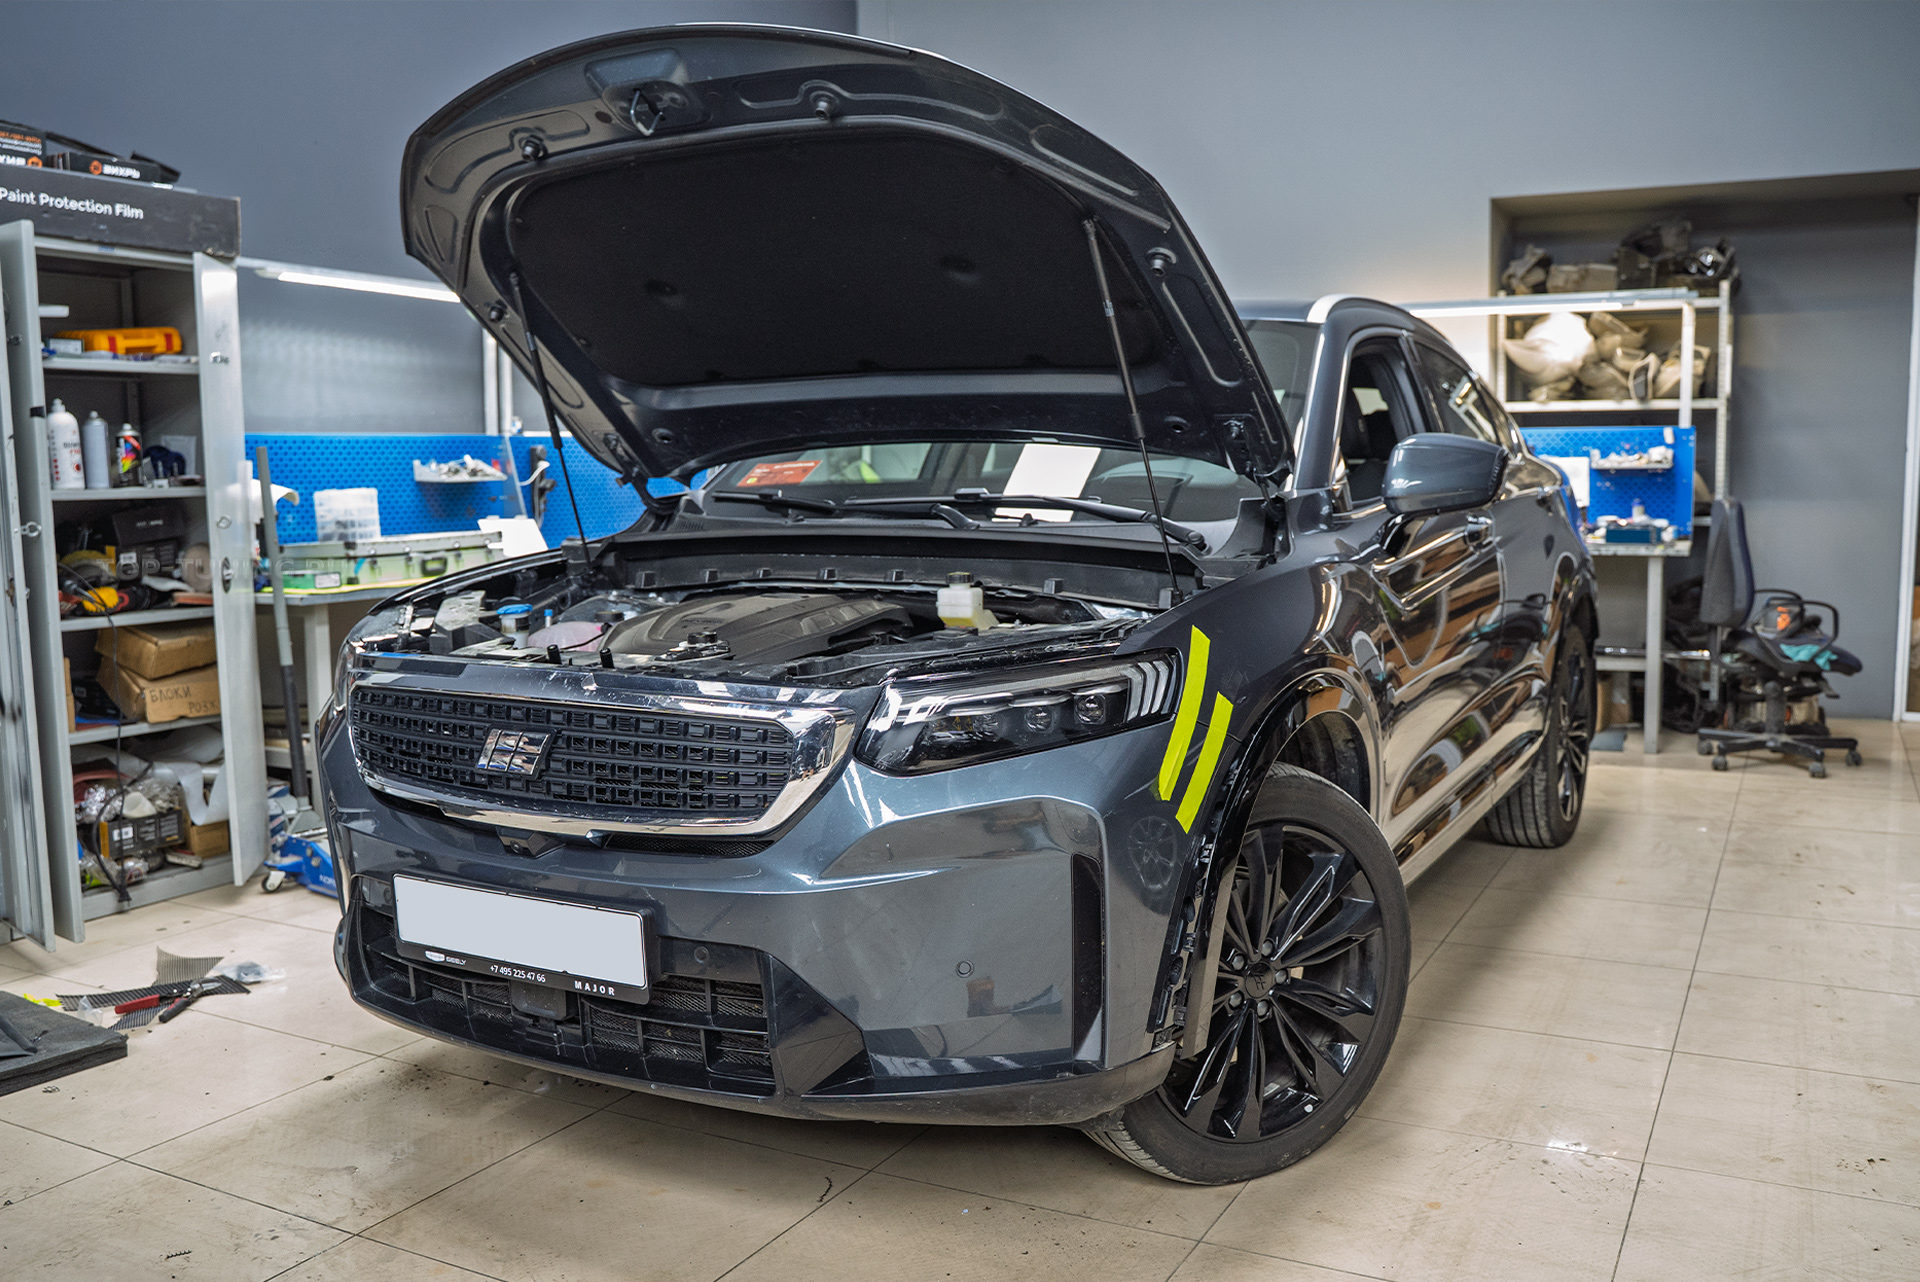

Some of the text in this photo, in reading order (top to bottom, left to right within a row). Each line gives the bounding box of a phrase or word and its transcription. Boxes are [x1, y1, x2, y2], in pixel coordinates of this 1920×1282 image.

[0, 187, 144, 220] Paint Protection Film
[149, 686, 192, 703] БЛОКИ
[490, 964, 546, 983] +7 495 225 47 66
[574, 980, 615, 997] MAJOR
